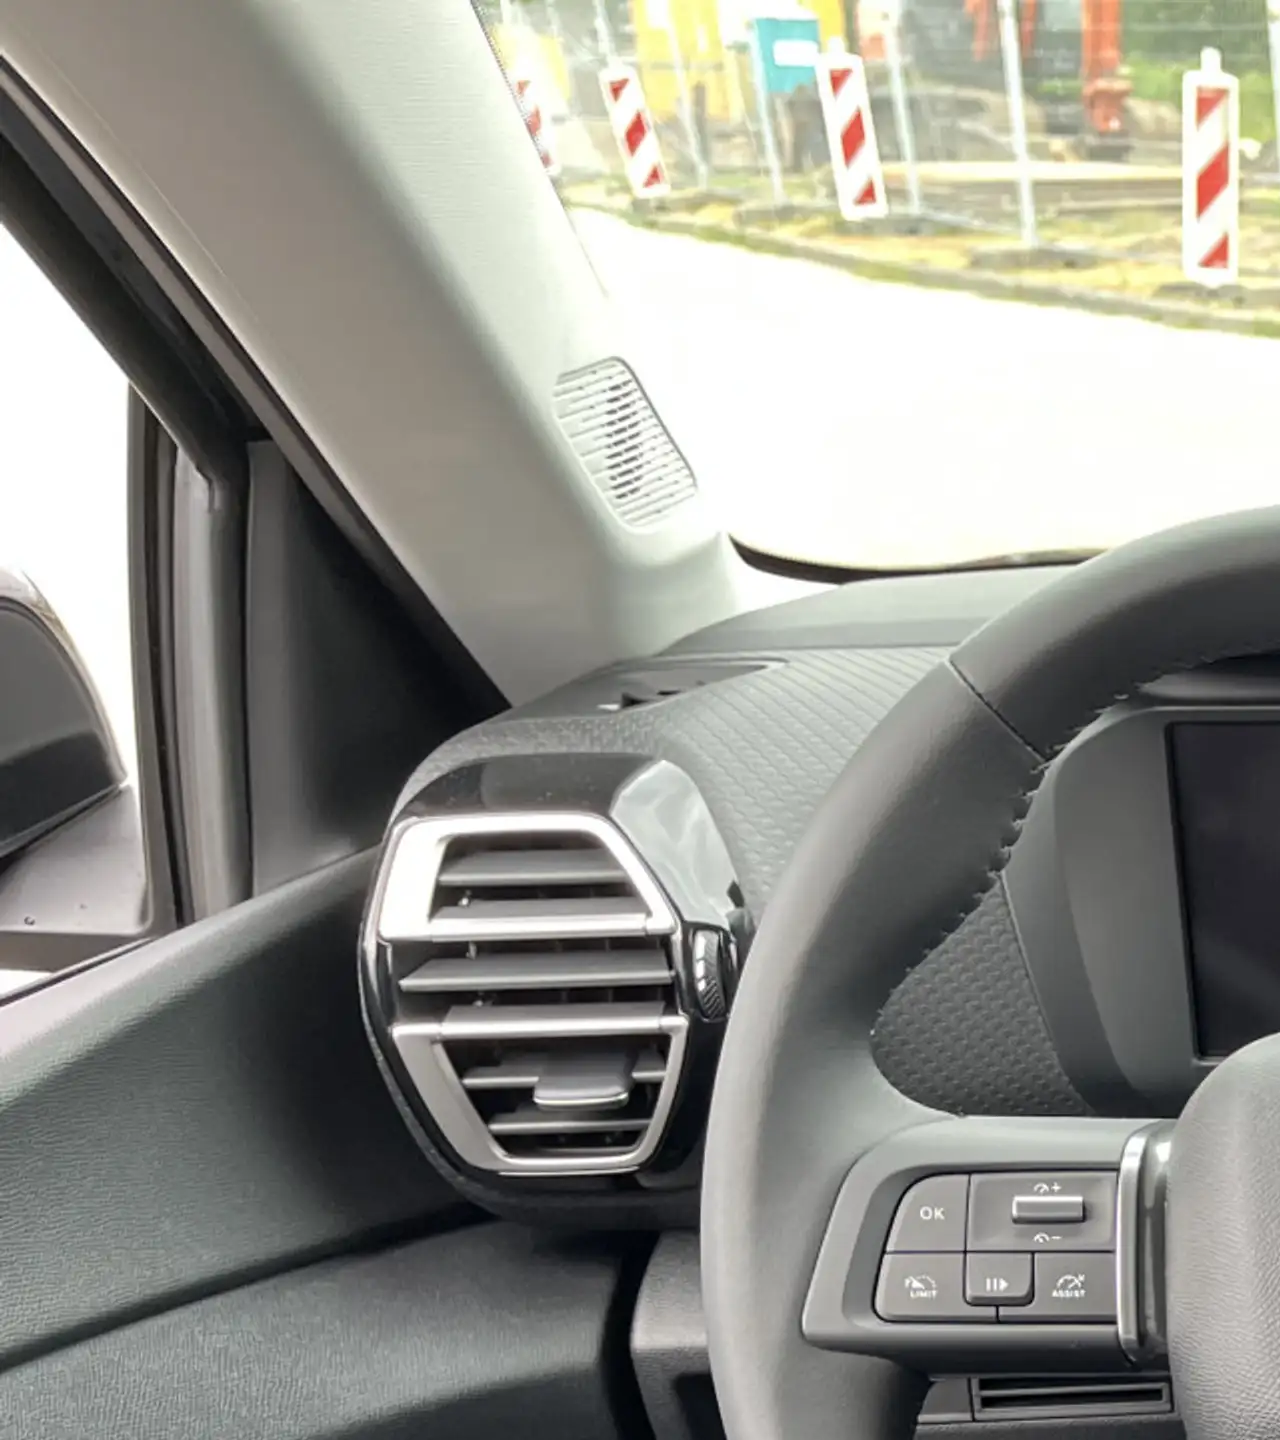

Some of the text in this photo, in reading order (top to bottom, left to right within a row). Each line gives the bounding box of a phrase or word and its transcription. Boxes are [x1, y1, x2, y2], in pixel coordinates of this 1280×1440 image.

[919, 1206, 946, 1221] OK
[909, 1289, 938, 1299] LIMIT
[1051, 1289, 1087, 1299] ASSIST
